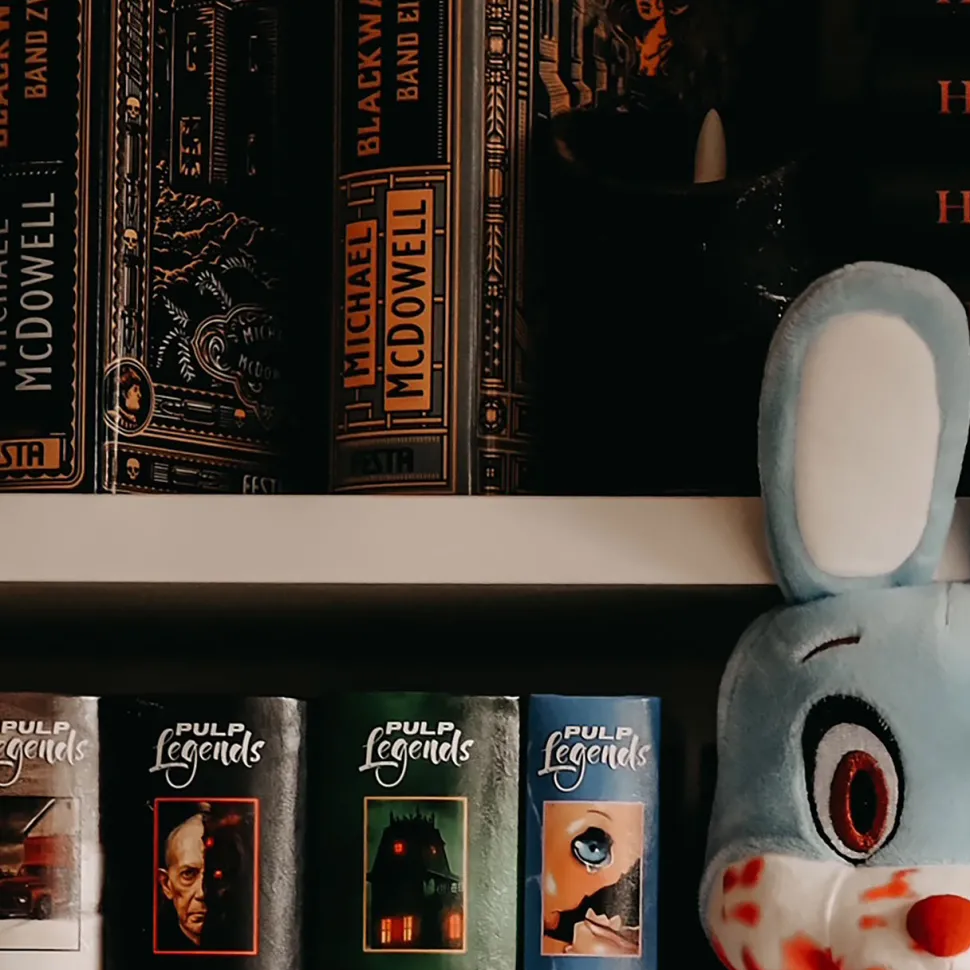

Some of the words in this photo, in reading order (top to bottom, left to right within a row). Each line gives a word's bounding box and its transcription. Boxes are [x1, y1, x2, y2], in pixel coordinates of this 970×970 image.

[25, 31, 48, 99] BAND
[397, 33, 419, 101] BAND
[15, 192, 55, 391] MCDOWELL
[344, 223, 373, 385] MICHAEL
[387, 199, 427, 398] MCDOWELL
[1, 720, 70, 735] PULP
[149, 728, 265, 788] Legends
[175, 722, 245, 737] PULP
[358, 727, 475, 788] Legends
[385, 721, 455, 736] PULP
[564, 725, 634, 741] PULP
[537, 731, 651, 793] Legends
